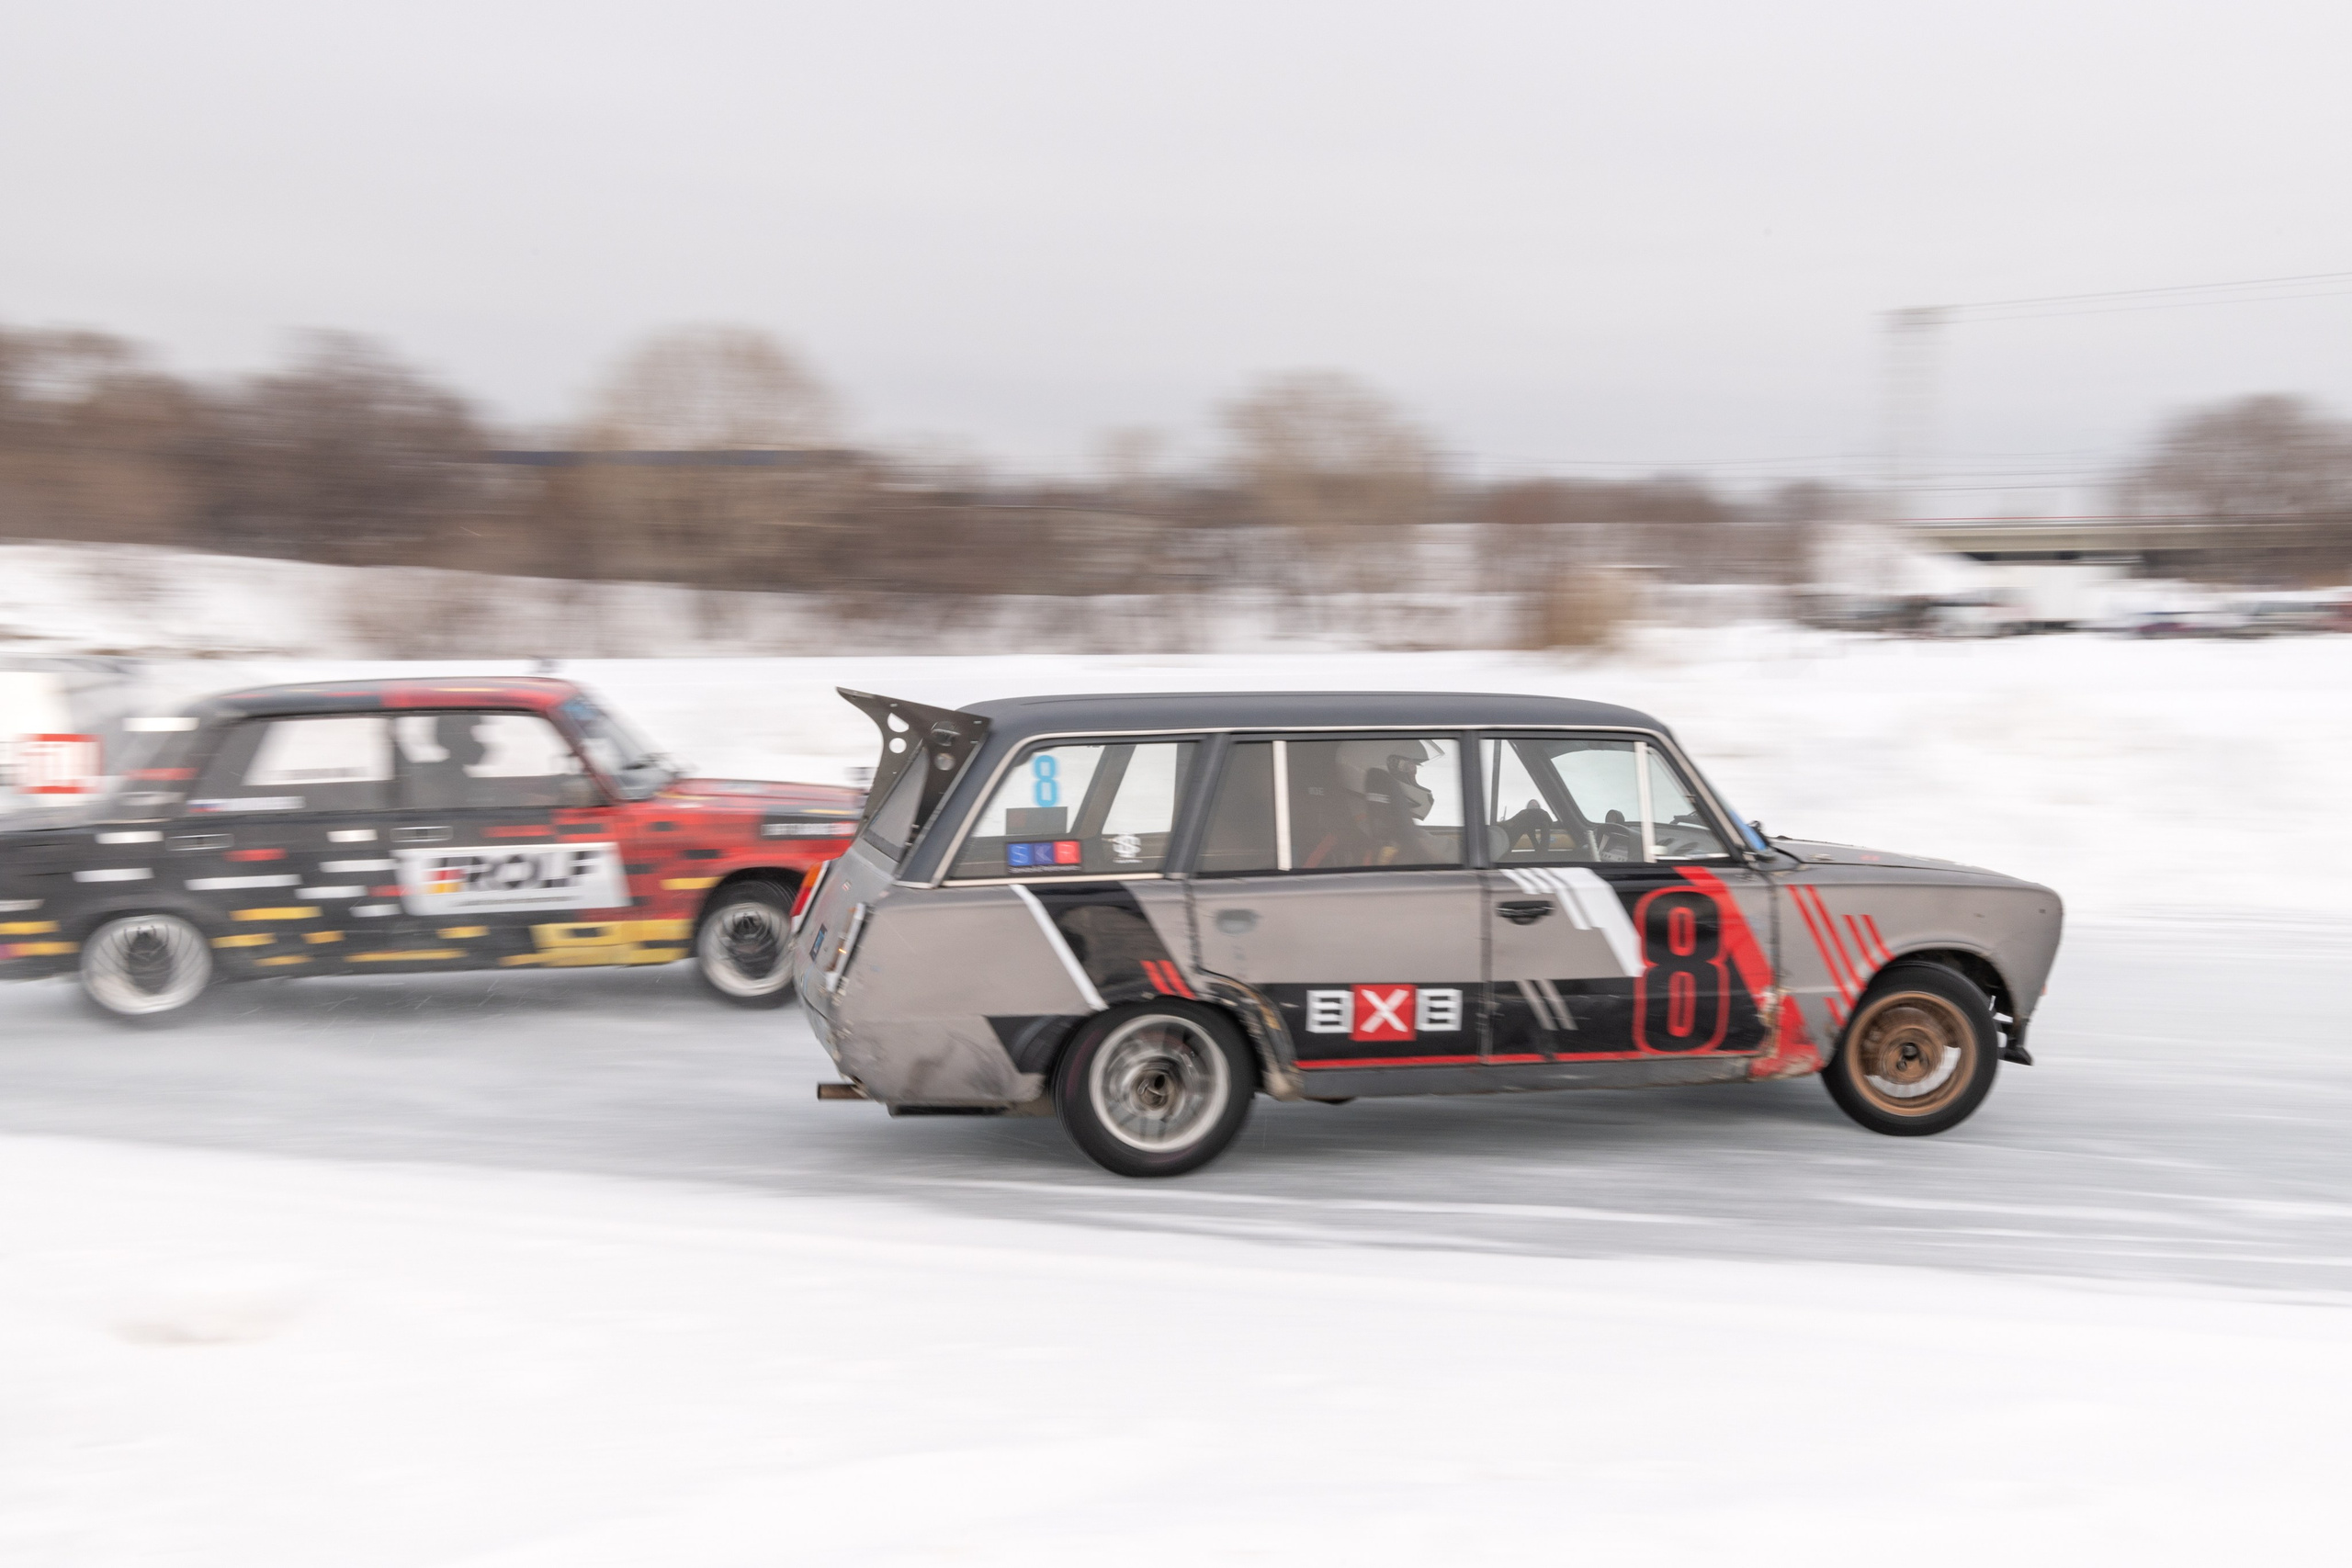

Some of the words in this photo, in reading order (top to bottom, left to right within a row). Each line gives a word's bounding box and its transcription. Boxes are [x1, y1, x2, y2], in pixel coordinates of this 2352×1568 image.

[1033, 754, 1058, 807] 8
[461, 851, 605, 891] ROLF
[1633, 886, 1730, 1055] 8
